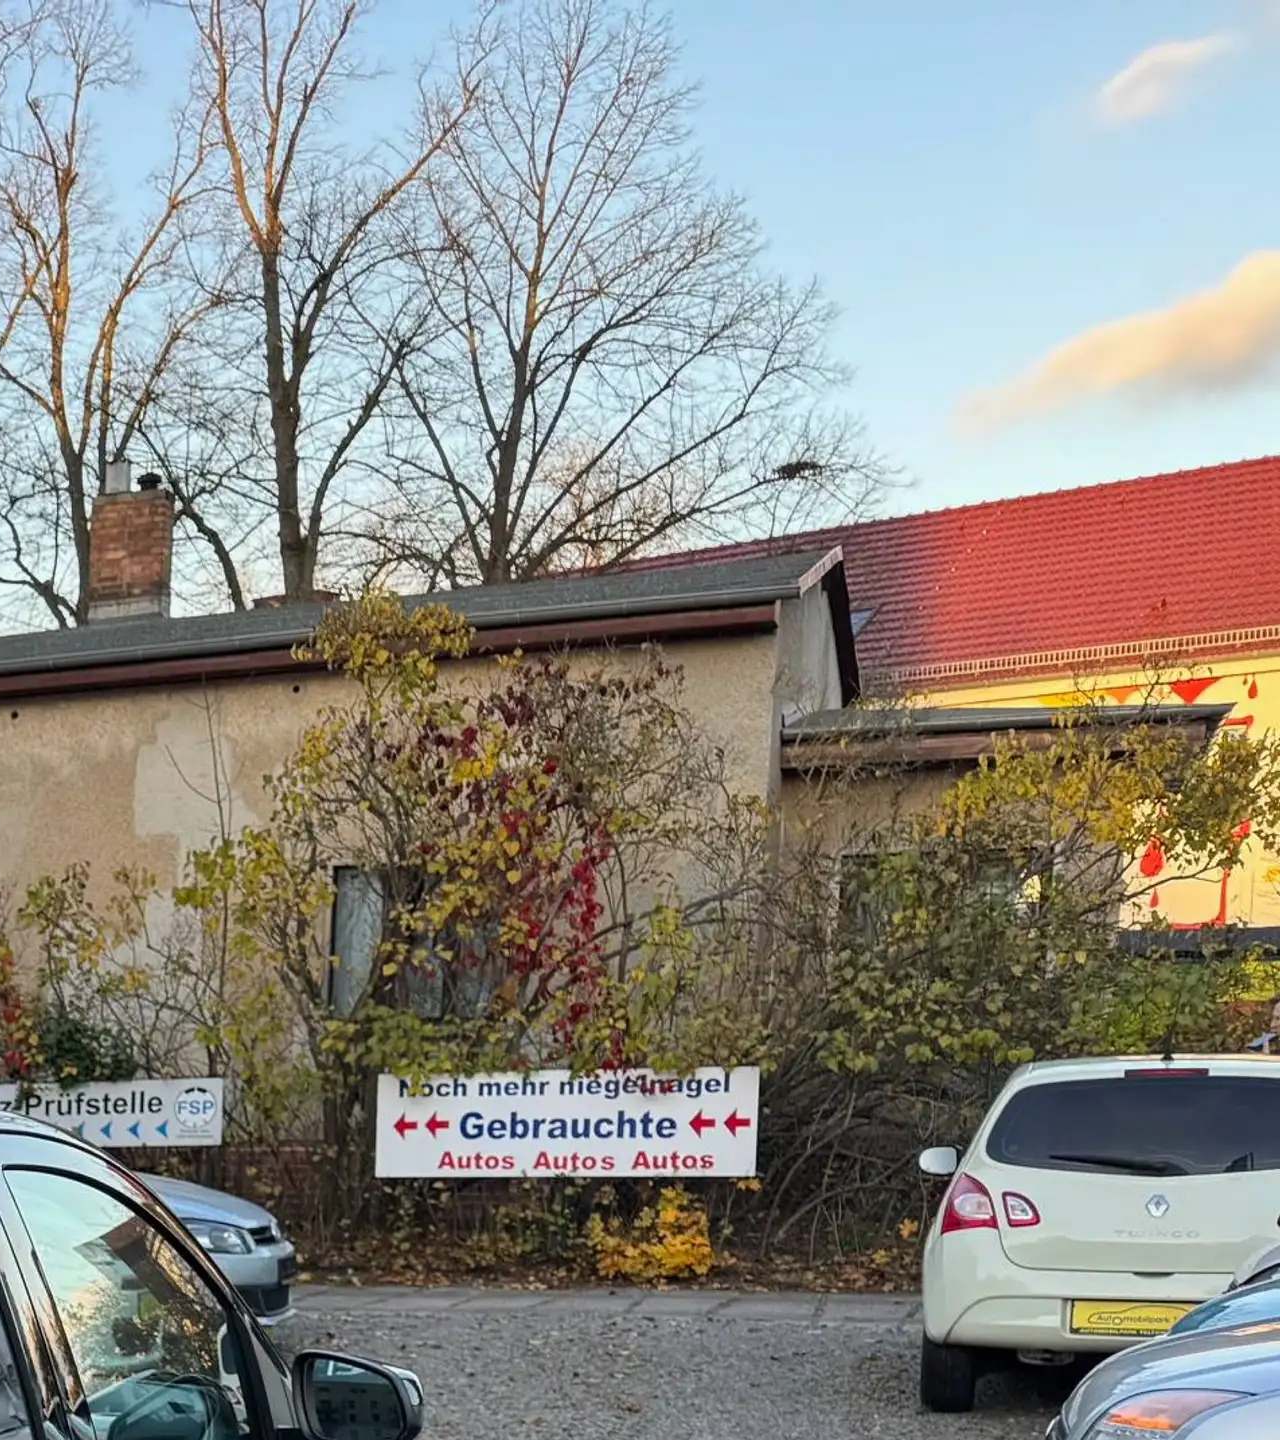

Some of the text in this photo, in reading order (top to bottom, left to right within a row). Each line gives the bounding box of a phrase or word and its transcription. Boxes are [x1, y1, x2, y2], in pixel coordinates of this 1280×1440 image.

[478, 1075, 549, 1097] mehr
[176, 1101, 215, 1116] FSP
[458, 1110, 677, 1141] Gebrauchte
[437, 1150, 715, 1171] Autos Autos Autos
